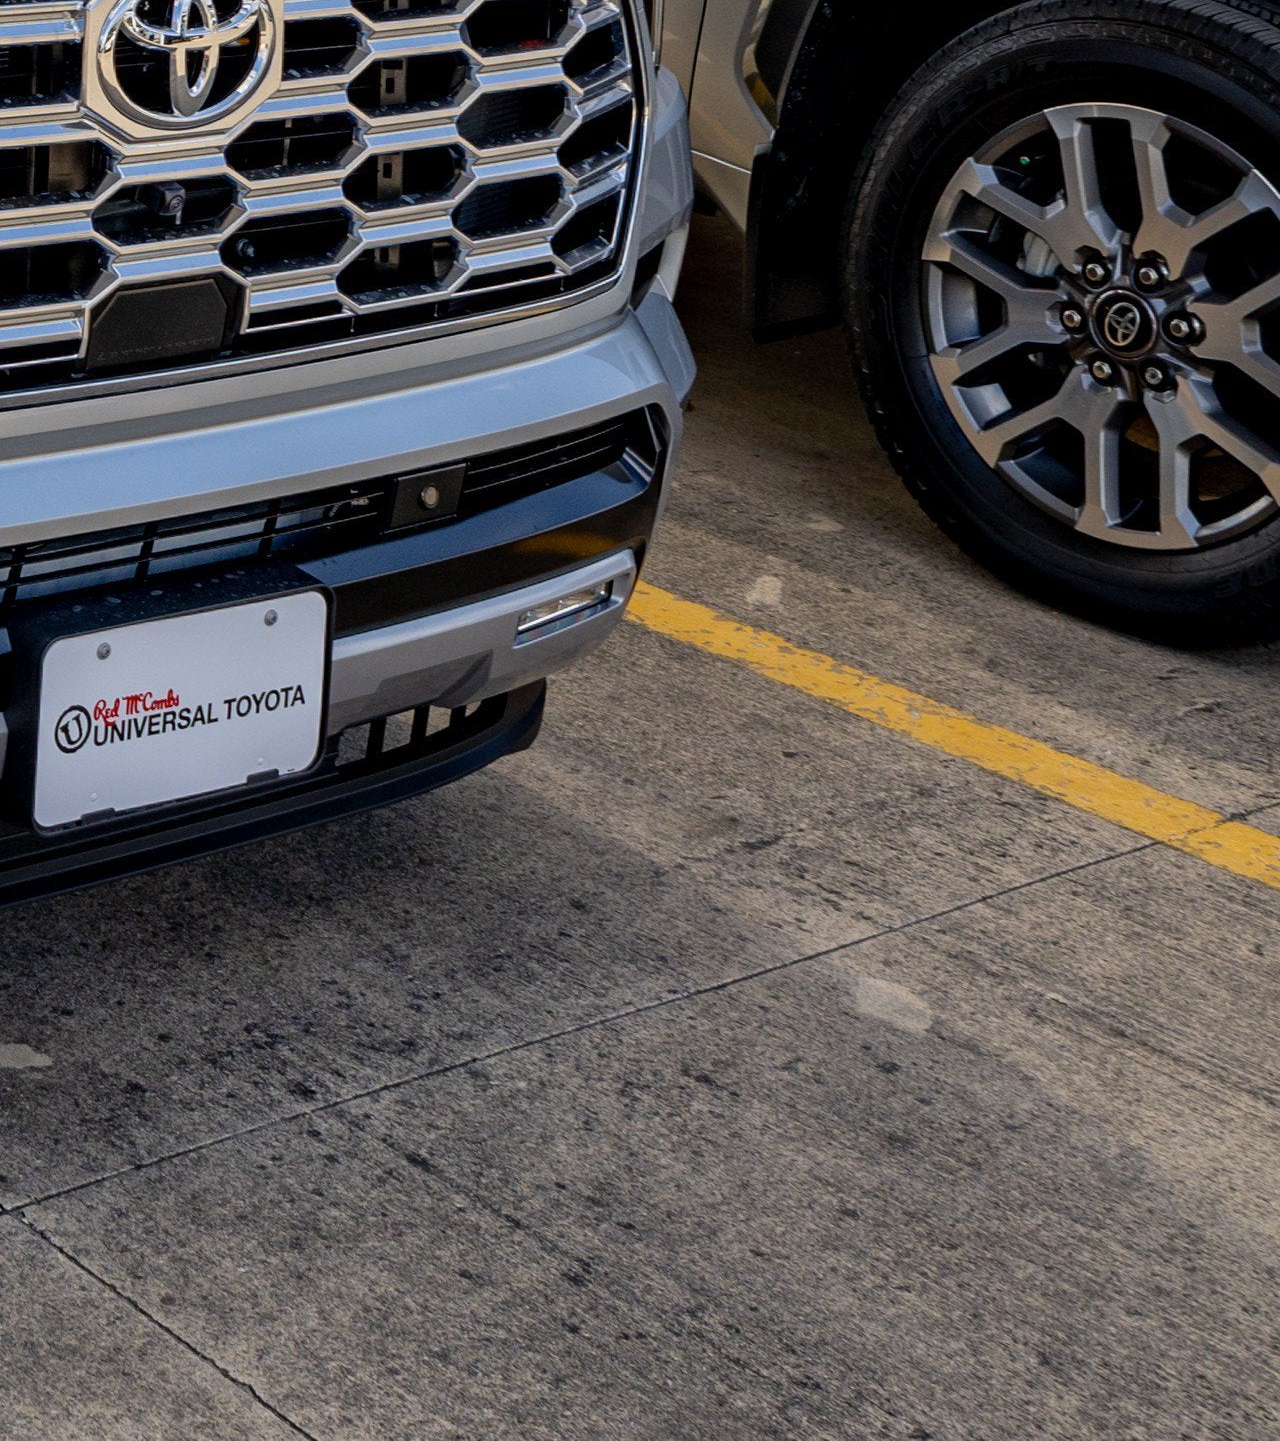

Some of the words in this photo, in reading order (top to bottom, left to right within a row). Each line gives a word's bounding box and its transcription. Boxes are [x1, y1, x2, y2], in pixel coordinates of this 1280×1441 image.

[93, 697, 121, 727] Red
[122, 688, 180, 715] McCombs
[93, 703, 219, 747] UNIVERSAL
[223, 685, 306, 720] TOYOTA
